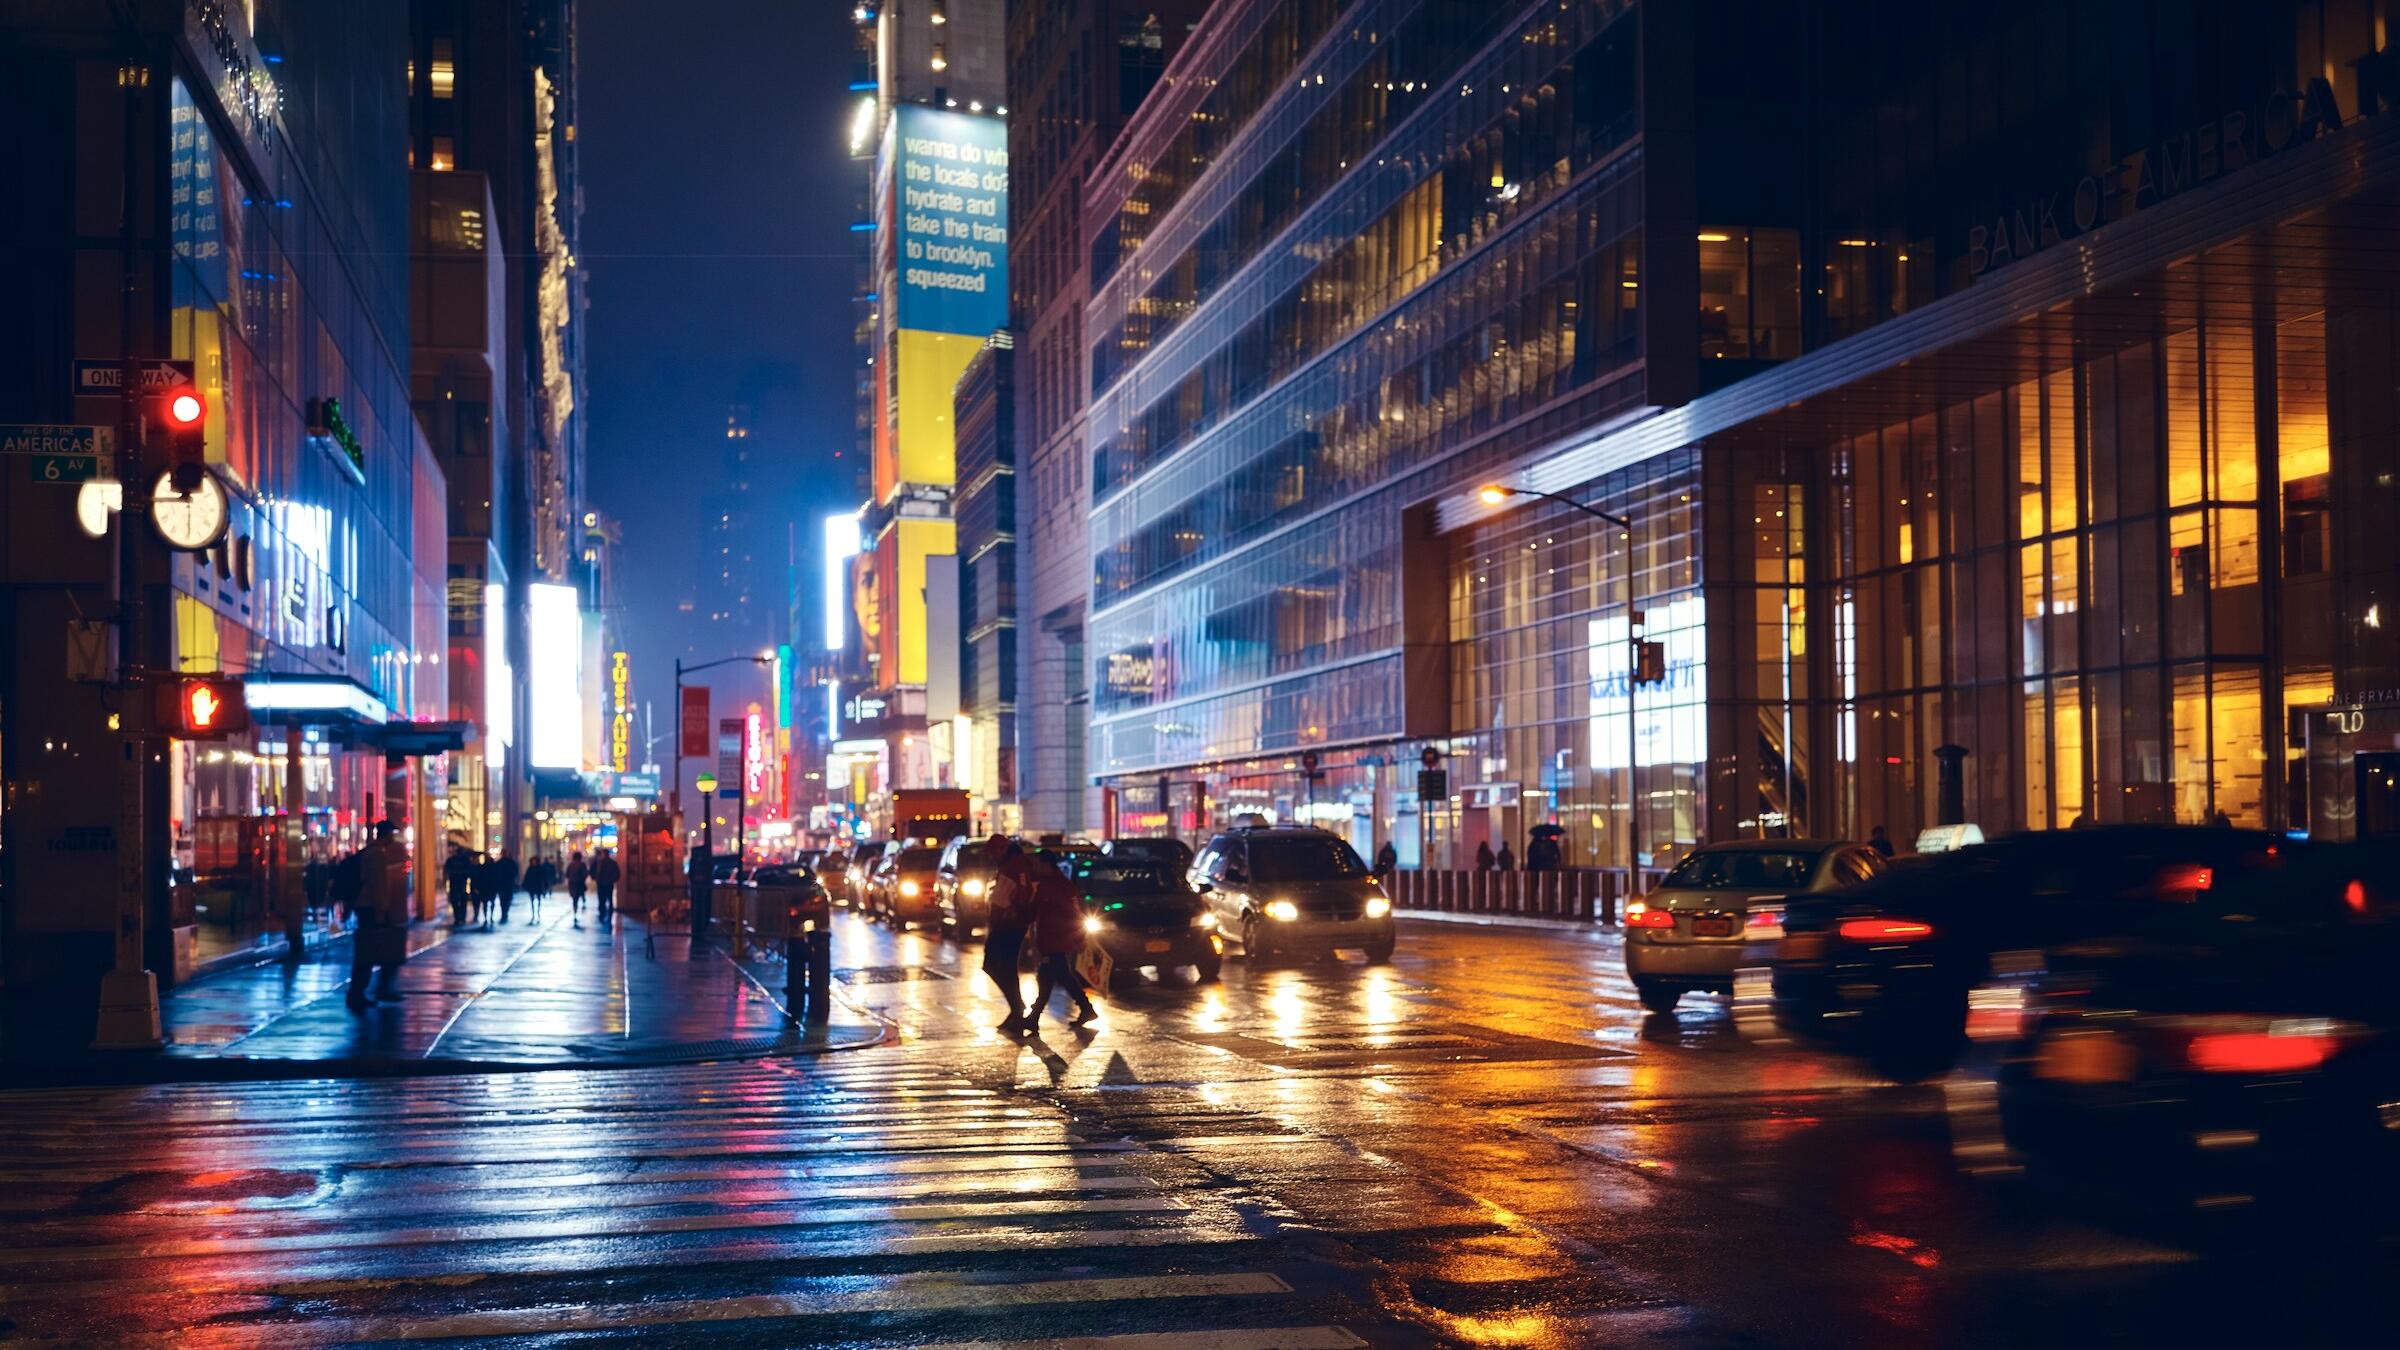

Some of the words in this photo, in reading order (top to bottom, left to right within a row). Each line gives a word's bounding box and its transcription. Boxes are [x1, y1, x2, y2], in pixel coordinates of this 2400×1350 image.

[905, 137, 957, 160] wanna
[960, 142, 981, 163] do
[905, 160, 931, 182] the
[935, 164, 979, 189] locals
[1968, 190, 2065, 277] BANK
[2074, 163, 2135, 232] OF
[2133, 77, 2343, 209] AMERICA
[906, 186, 963, 211] hydrate
[966, 197, 996, 217] and
[906, 212, 940, 235] take
[944, 217, 969, 239] the
[972, 221, 1008, 244] train
[906, 239, 922, 259] to
[926, 241, 995, 270] brooklyn.
[906, 267, 986, 292] squeezed
[91, 370, 122, 385] ONE
[141, 369, 177, 385] WAY
[22, 426, 40, 435] AVE
[43, 426, 54, 435] OF
[58, 427, 75, 435] THE
[3, 437, 95, 452] AMERICAS
[44, 459, 61, 480] 6
[67, 459, 86, 470] AV
[612, 652, 627, 772] TUSSAUDS
